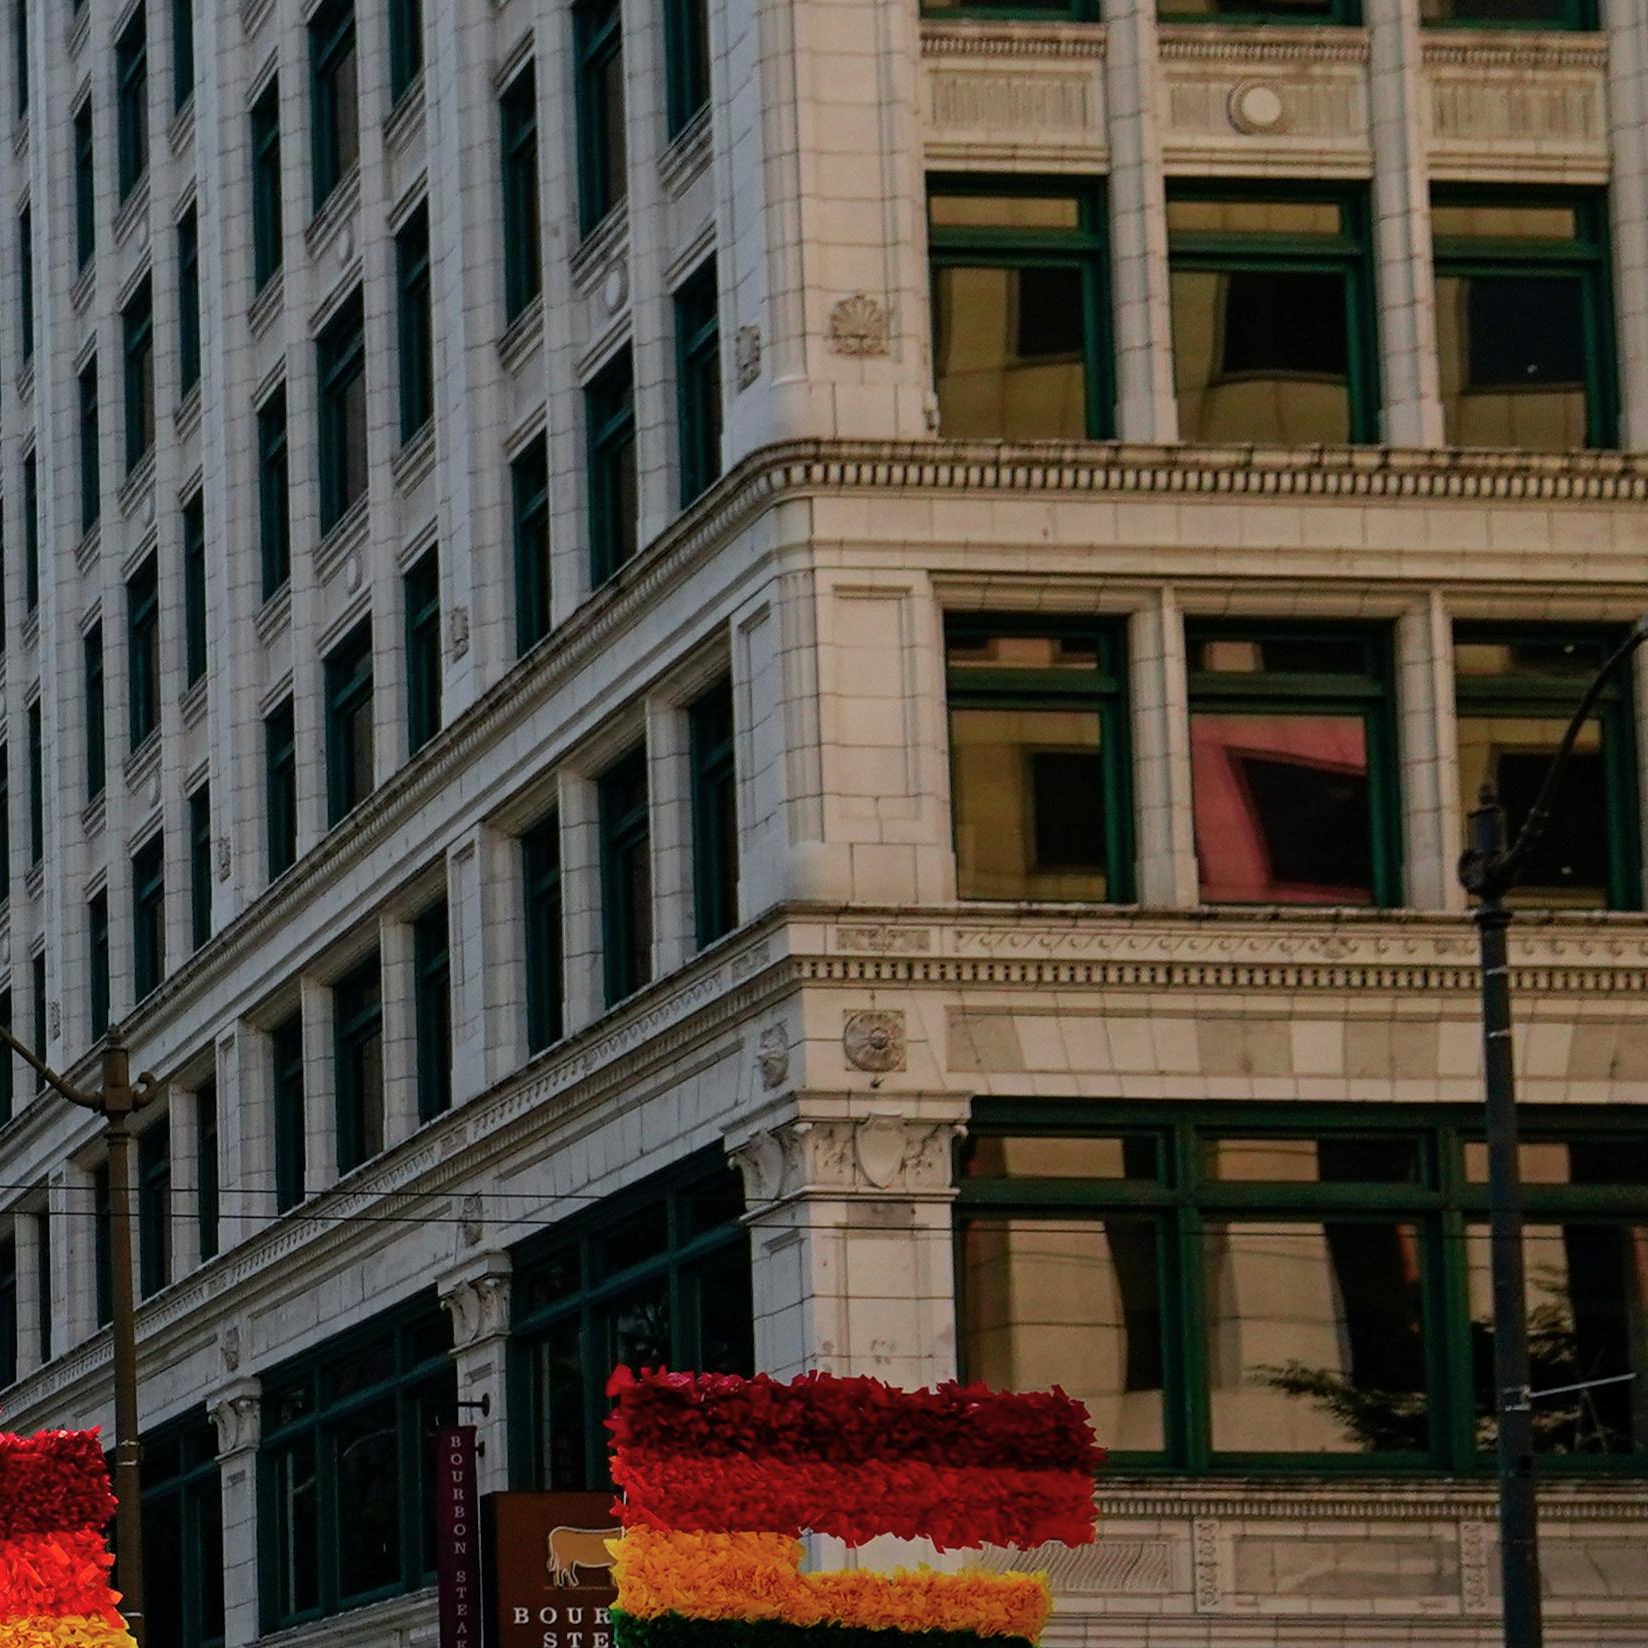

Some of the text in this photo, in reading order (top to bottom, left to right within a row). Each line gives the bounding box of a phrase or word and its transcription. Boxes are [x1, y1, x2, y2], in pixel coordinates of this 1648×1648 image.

[450, 1436, 466, 1554] BOURBON
[513, 1607, 612, 1625] BOUR
[543, 1632, 610, 1648] STE
